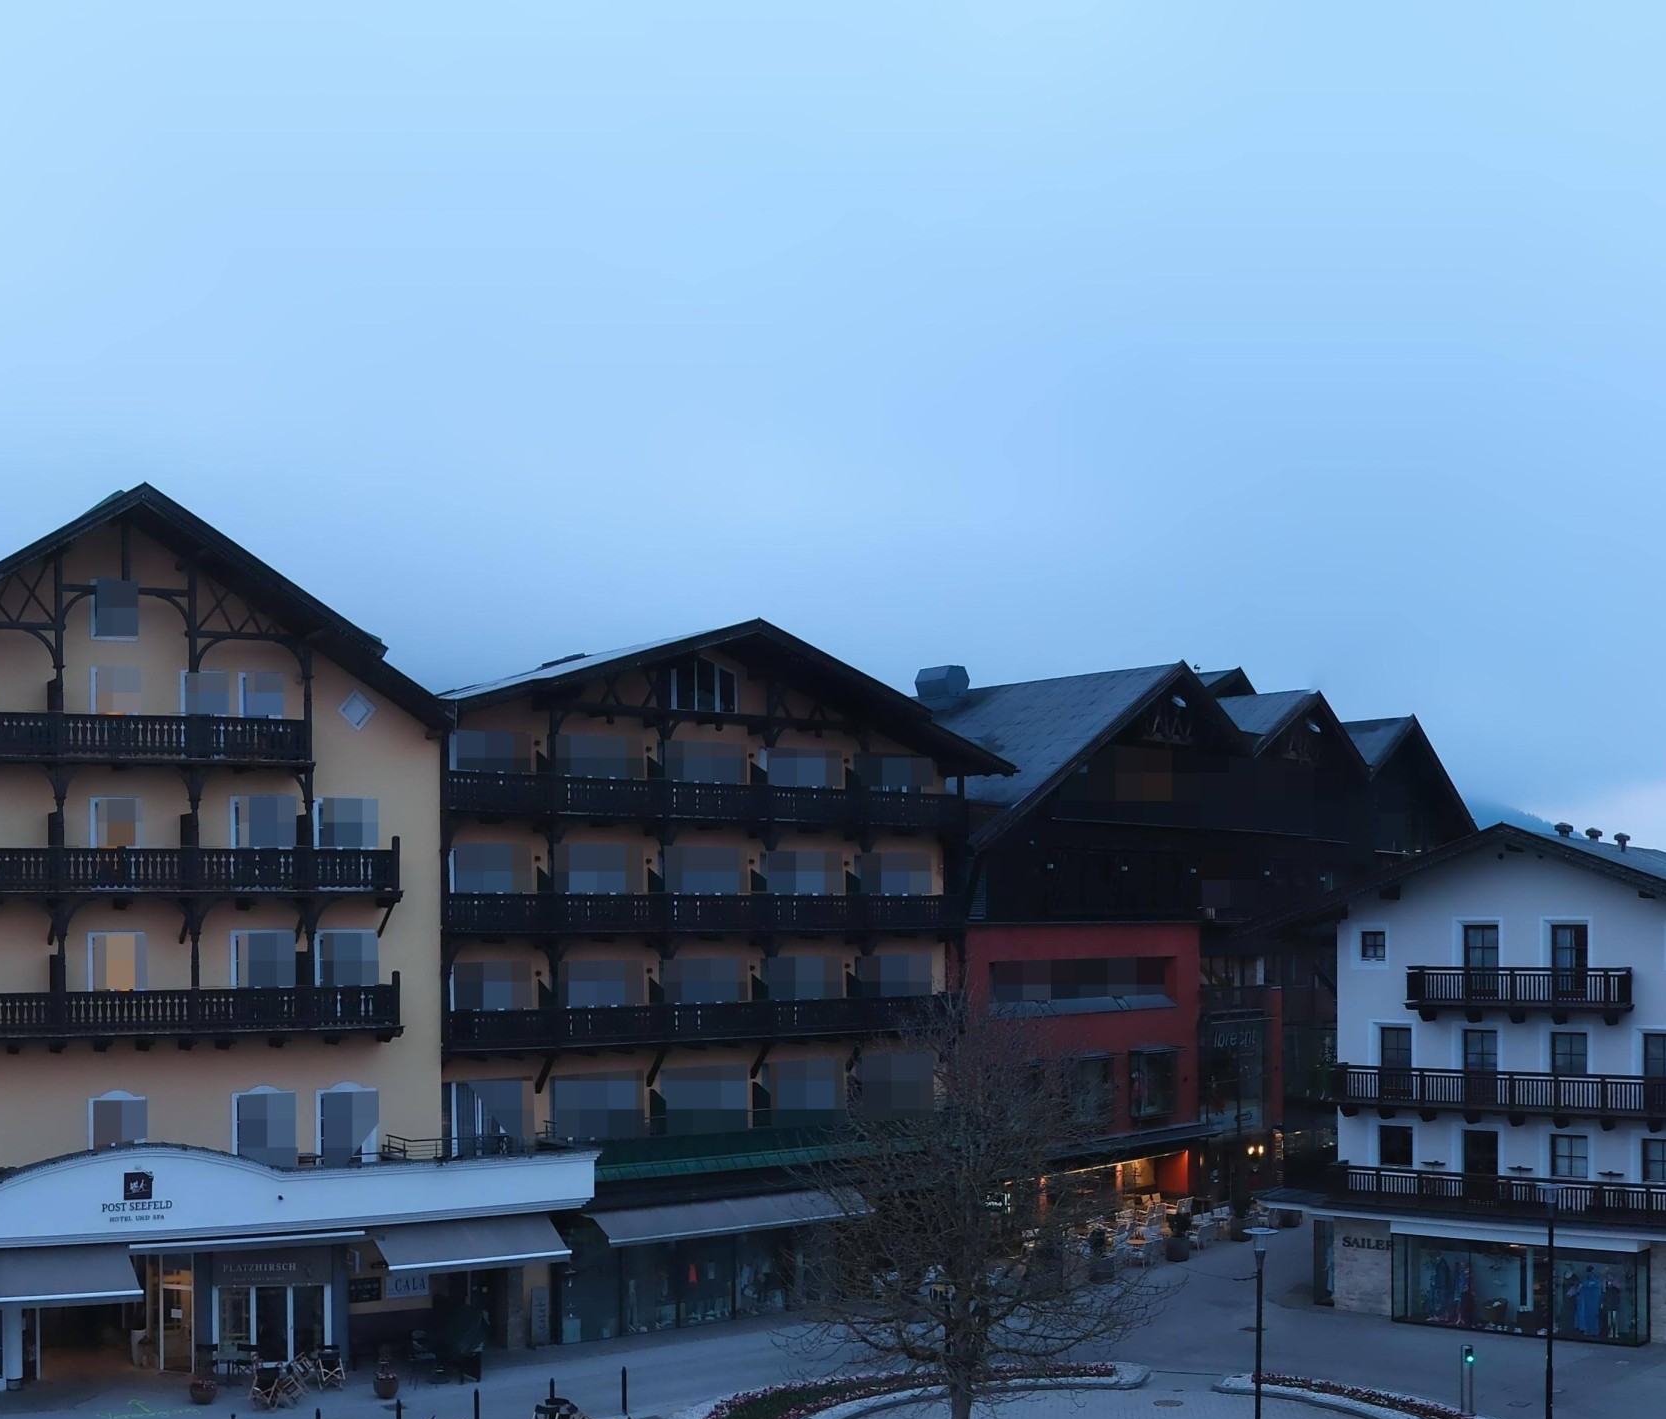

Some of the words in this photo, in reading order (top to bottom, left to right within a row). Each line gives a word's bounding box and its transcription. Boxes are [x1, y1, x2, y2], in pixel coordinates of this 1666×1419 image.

[102, 1202, 127, 1212] POST
[129, 1200, 173, 1211] SEEFELD
[223, 1262, 297, 1273] PLATZHIRSCH
[395, 1276, 426, 1292] CALA
